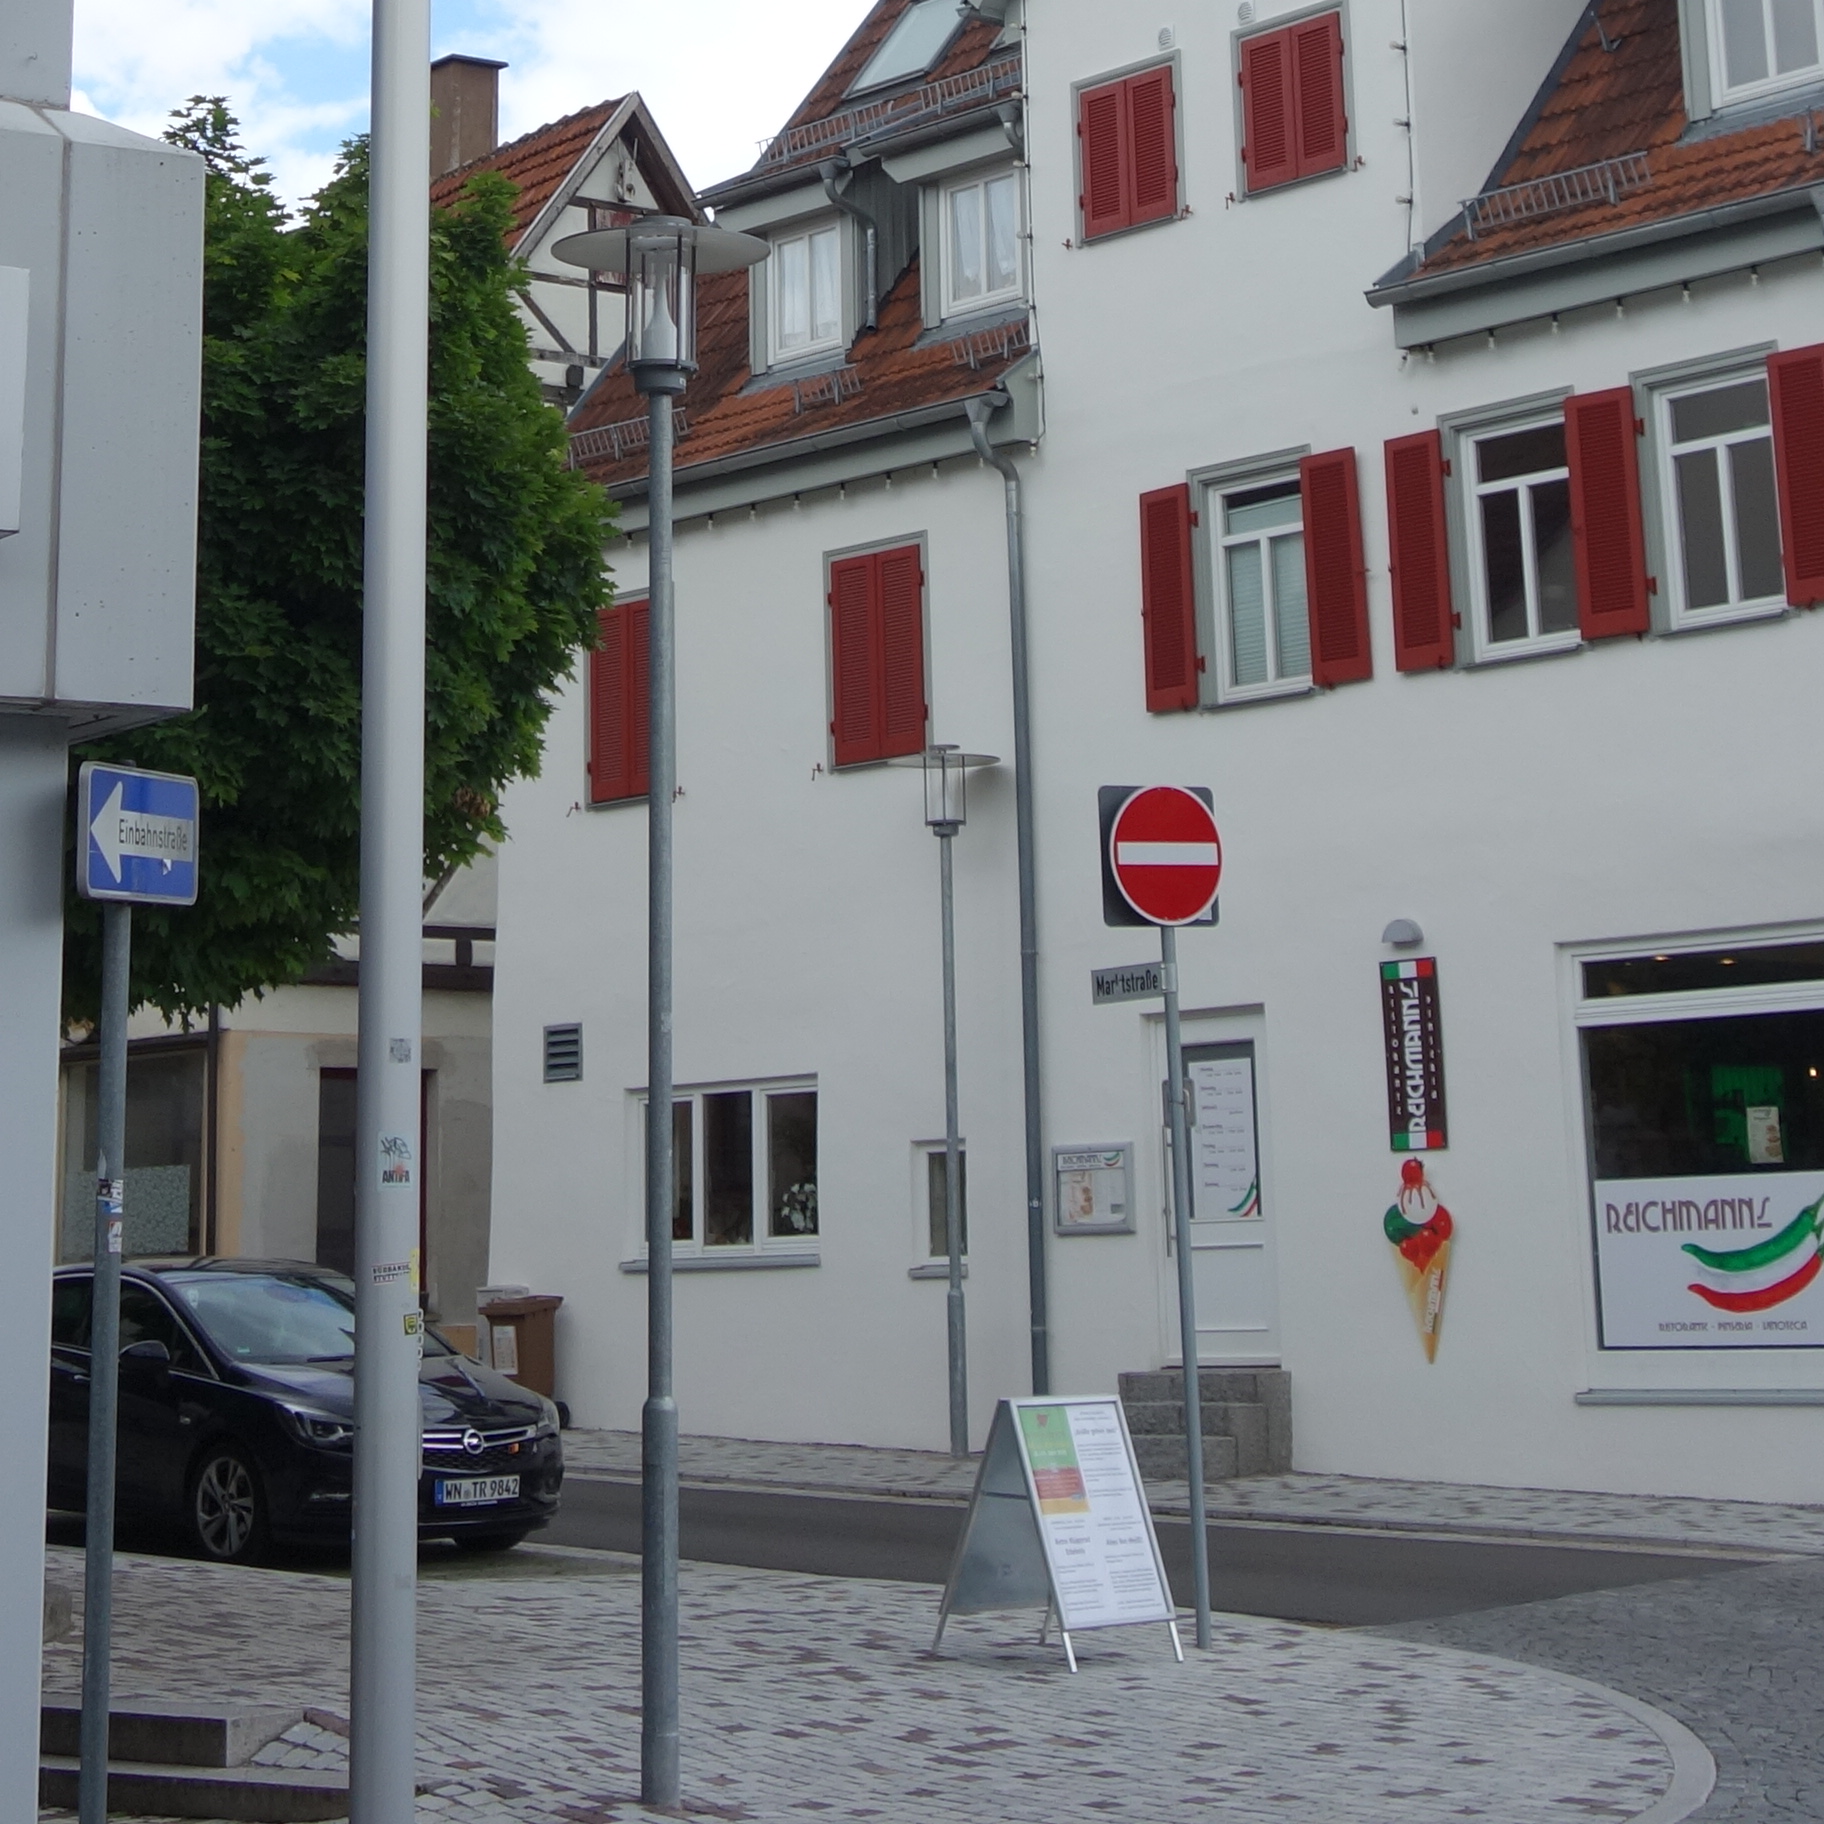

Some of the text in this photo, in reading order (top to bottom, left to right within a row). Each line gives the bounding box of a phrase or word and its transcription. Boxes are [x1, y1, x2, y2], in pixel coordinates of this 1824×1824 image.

[118, 818, 188, 851] Einbahnstraße
[1606, 1196, 1772, 1233] REICHMANNS
[445, 1478, 518, 1500] WN TR 9842
